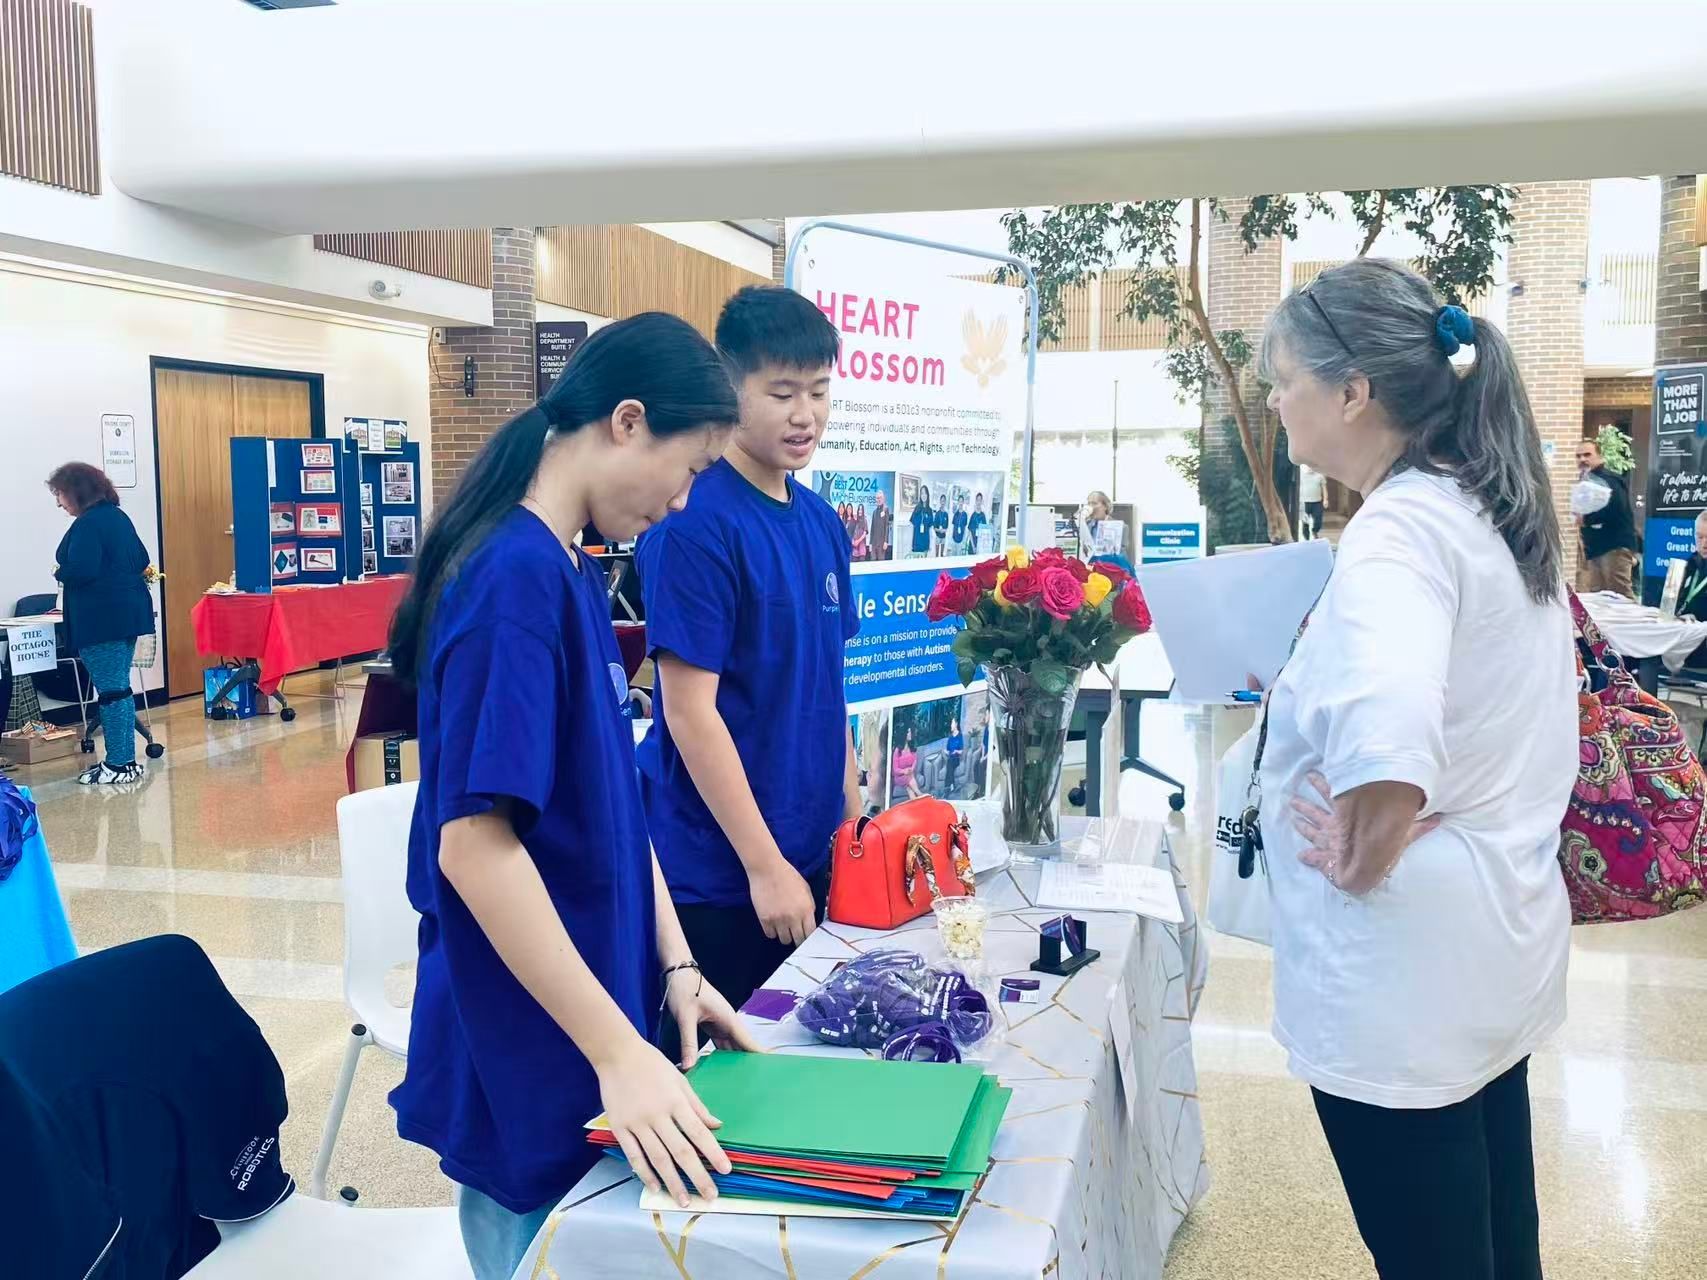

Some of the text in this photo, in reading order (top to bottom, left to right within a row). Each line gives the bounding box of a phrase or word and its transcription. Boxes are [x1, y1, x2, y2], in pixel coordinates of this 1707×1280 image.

[816, 289, 920, 340] HEART
[836, 337, 945, 387] lossom
[1663, 383, 1698, 399] MORE
[844, 400, 880, 414] Blossom
[881, 403, 888, 414] is
[889, 405, 895, 414] a
[896, 403, 920, 415] 501c3
[921, 406, 956, 417] nonprofit
[956, 408, 994, 420] committed
[1663, 397, 1698, 412] THAN
[1662, 410, 1697, 425] A JOB
[827, 420, 866, 434] powering
[867, 422, 910, 434] individuals
[911, 424, 925, 434] and
[926, 425, 973, 436] communities
[859, 439, 902, 453] Education,
[903, 441, 917, 453] Art,
[919, 442, 945, 455] Rights,
[946, 444, 960, 453] and
[848, 476, 879, 492] 2024
[1662, 487, 1680, 505] life
[1680, 488, 1690, 502] to
[1145, 528, 1196, 537] Immunization
[1670, 525, 1693, 537] Great
[1666, 541, 1689, 552] Great
[857, 590, 931, 619] le Sens
[21, 629, 43, 640] THE
[862, 634, 870, 646] is
[870, 635, 882, 645] on
[883, 633, 888, 643] a
[889, 628, 919, 641] mission
[920, 629, 929, 638] to
[929, 623, 958, 638] provide
[10, 638, 55, 652] OCTAGON
[16, 649, 51, 662] HOUSE
[843, 643, 951, 668] herapy to those with Autism
[848, 665, 907, 686] developmental
[908, 661, 945, 676] disorders.
[1217, 815, 1243, 835] red
[236, 1136, 276, 1192] ROBOTICS
